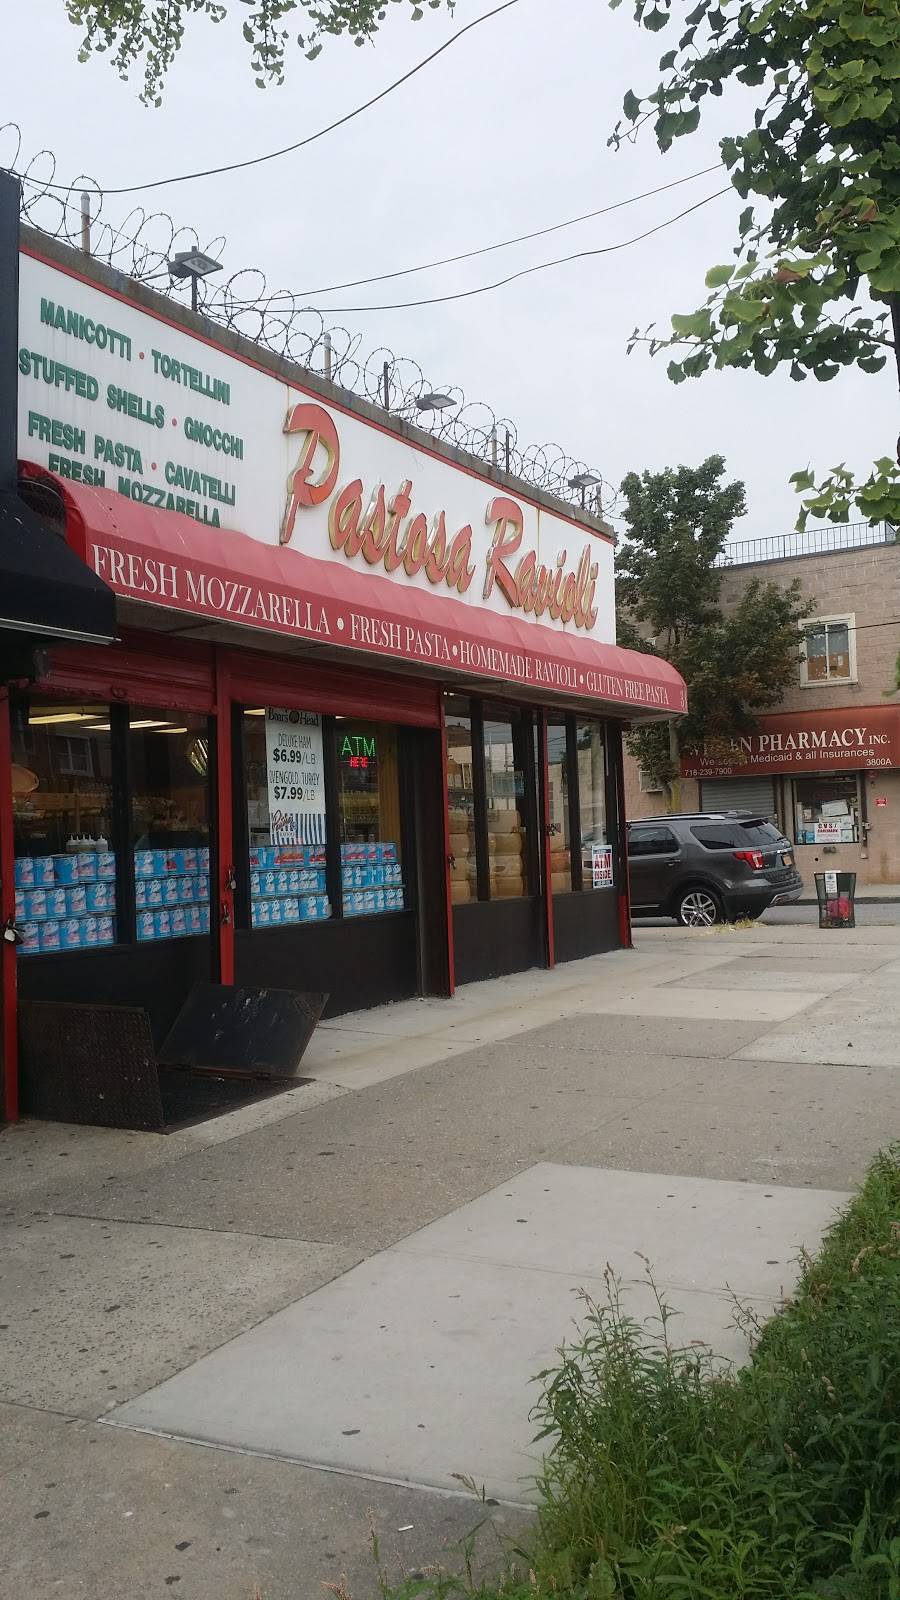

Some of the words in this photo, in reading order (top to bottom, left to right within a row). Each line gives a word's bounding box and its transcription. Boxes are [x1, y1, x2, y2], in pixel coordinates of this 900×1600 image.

[40, 297, 132, 362] MANICOTTI
[151, 348, 231, 406] TORTELLINI
[18, 347, 99, 402] STUFFED
[106, 383, 165, 430] SHELLS
[183, 416, 244, 460] GNOCCHI
[28, 410, 86, 454] FRESH
[94, 434, 143, 475] PASTA
[164, 461, 236, 507] CAVATELLI
[48, 452, 106, 488] FRESH
[117, 475, 221, 529] MOZZARELLA
[278, 402, 477, 594] Pastosa
[482, 496, 599, 631] Ravioli
[91, 543, 180, 599] FRESH
[184, 569, 332, 636] MOZZARELLA
[350, 613, 402, 650] FRESH
[405, 626, 451, 661] PASTA
[459, 639, 533, 680] HOMEMADE
[535, 658, 577, 688] RAVIOLI
[586, 671, 623, 697] GLUTEN
[624, 679, 645, 701] FREE
[645, 683, 669, 705] PASTA
[299, 711, 319, 727] Head
[298, 735, 312, 750] HAM
[341, 735, 376, 757] ATM
[758, 727, 867, 752] PHARMACY
[868, 734, 891, 745] INC.
[272, 747, 316, 765] $6.99/LB
[700, 757, 715, 766] We
[750, 752, 793, 764] Medicaid
[795, 751, 803, 761] &
[805, 750, 817, 760] all
[819, 748, 875, 759] Insurances
[865, 758, 892, 766] 3800A
[301, 771, 320, 786] TURKEY
[273, 785, 316, 802] $7.99/LB
[594, 853, 612, 870] ATM
[594, 869, 612, 880] INSIDE
